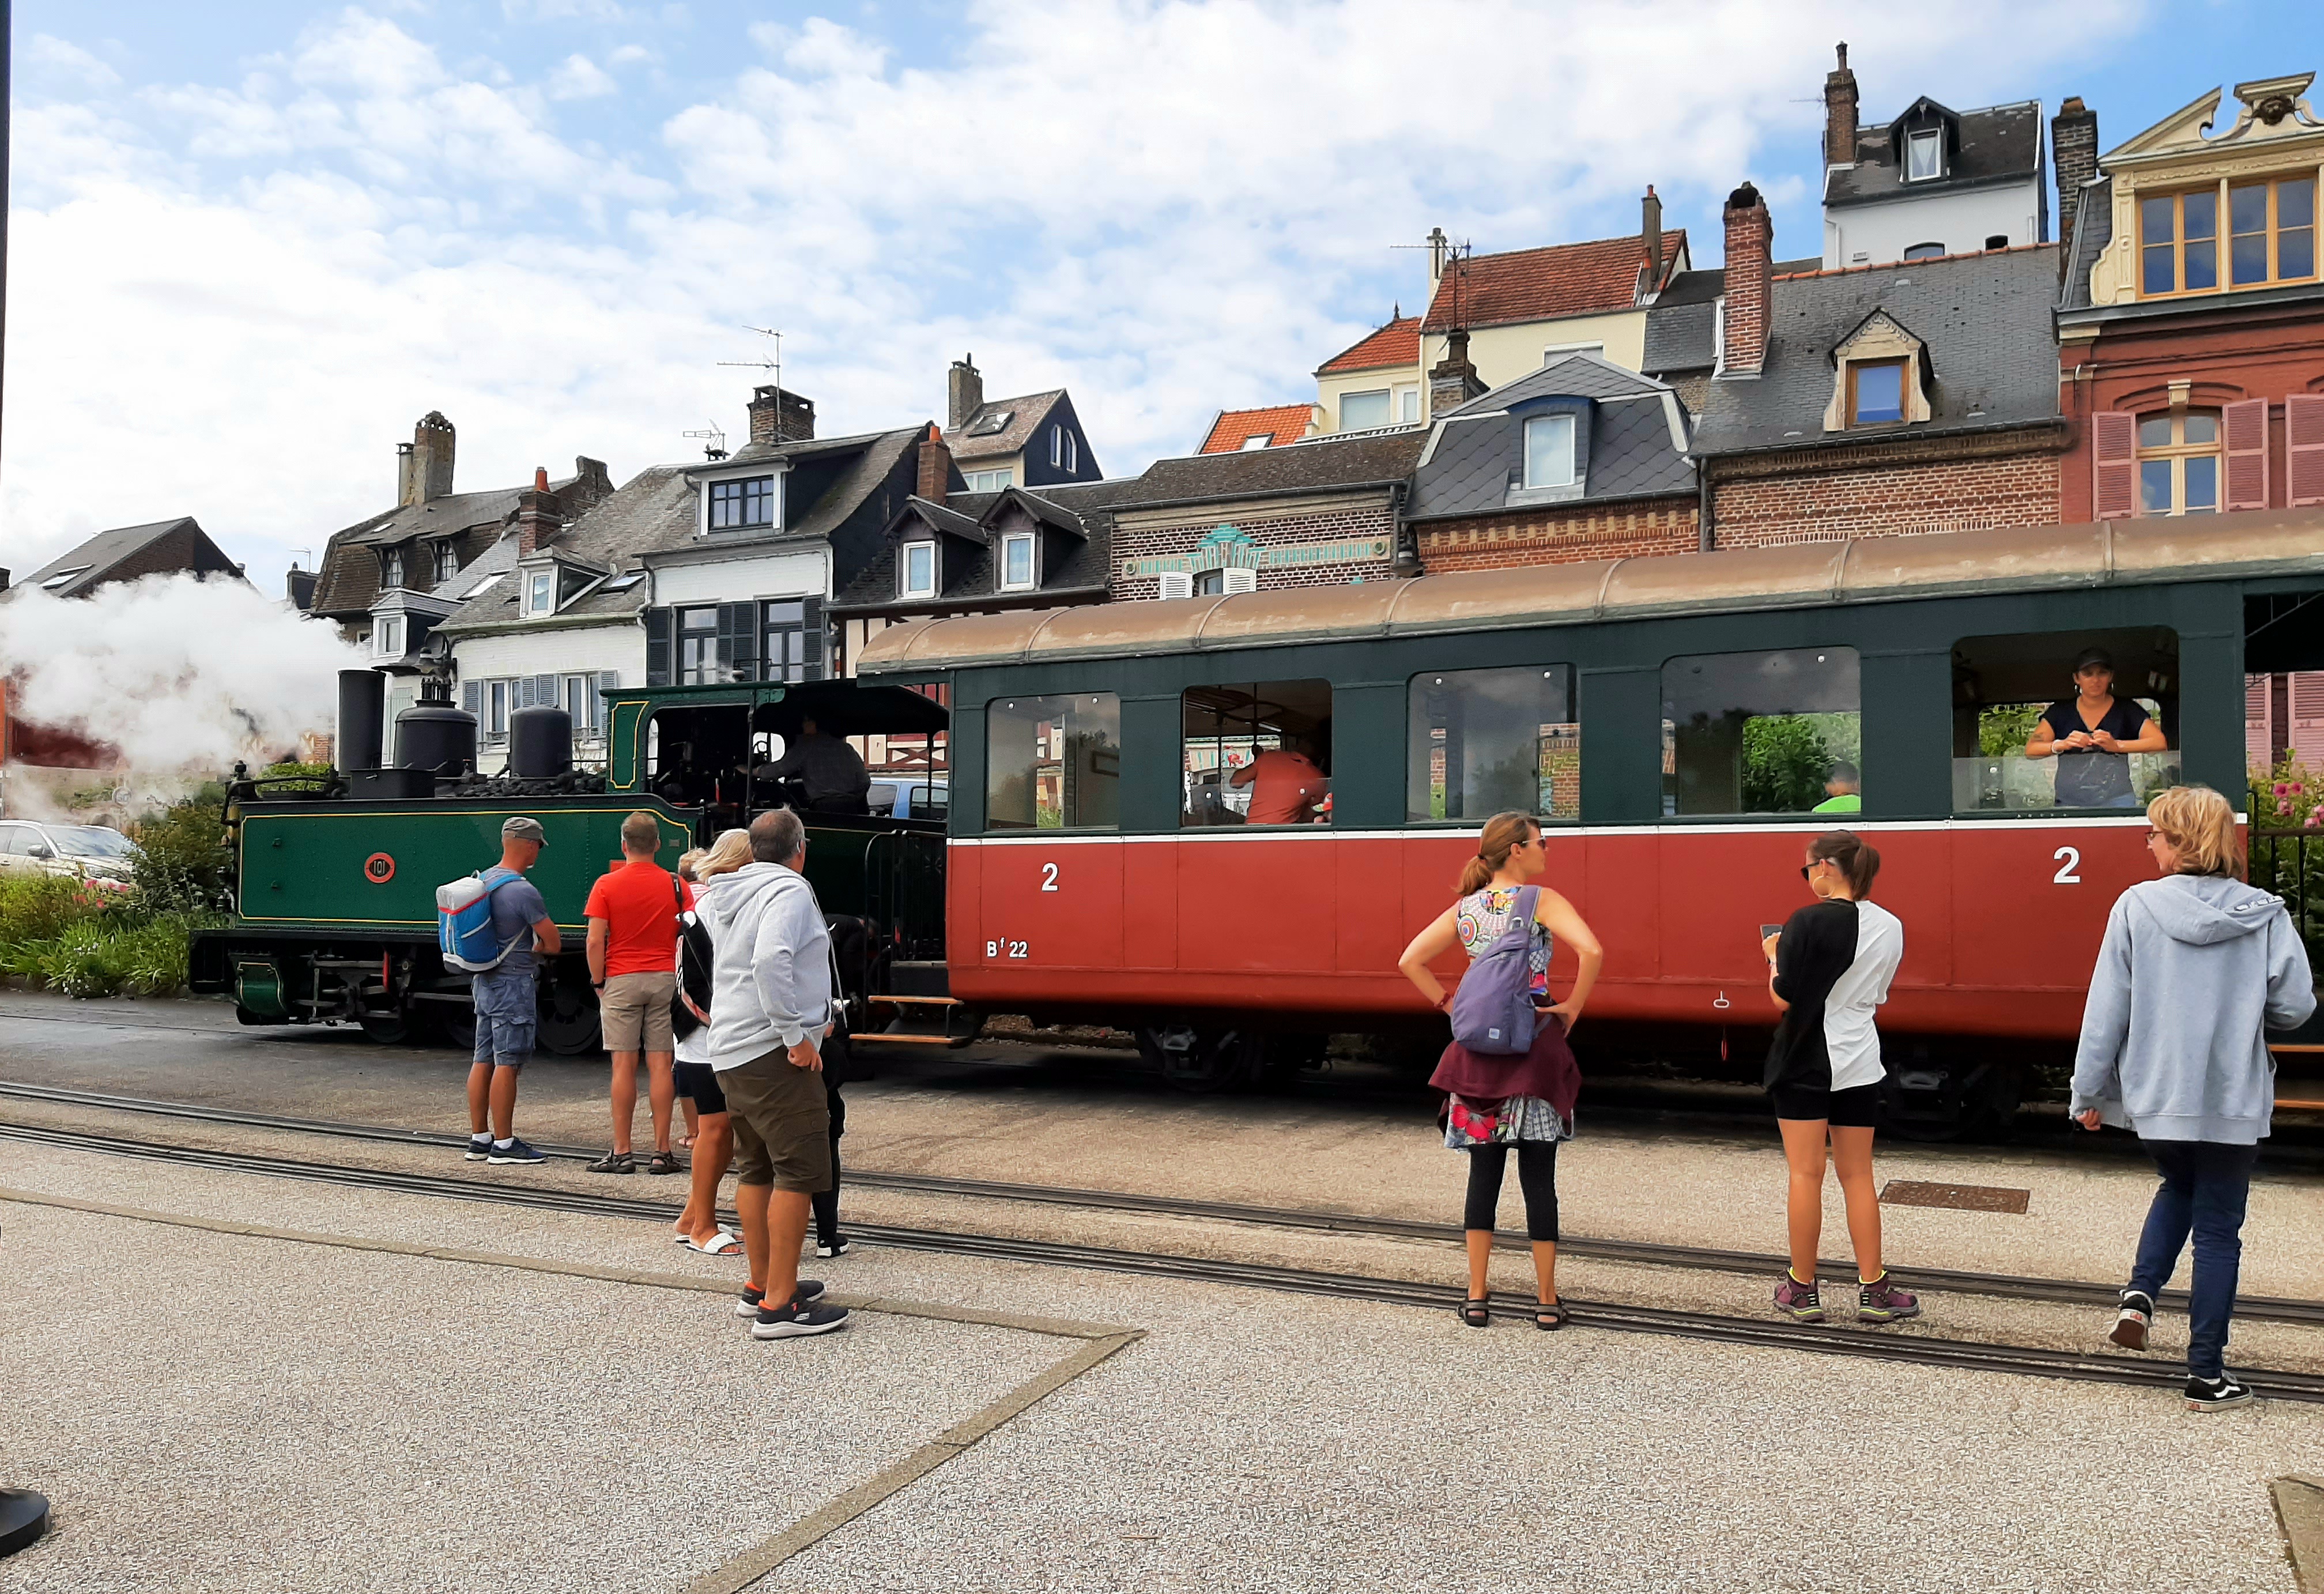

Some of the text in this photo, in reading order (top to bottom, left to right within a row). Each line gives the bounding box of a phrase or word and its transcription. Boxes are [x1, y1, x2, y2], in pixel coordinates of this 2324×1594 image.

[373, 860, 385, 875] 101
[2054, 846, 2080, 883] 2
[1042, 863, 1058, 891] 2
[1009, 941, 1028, 958] 22
